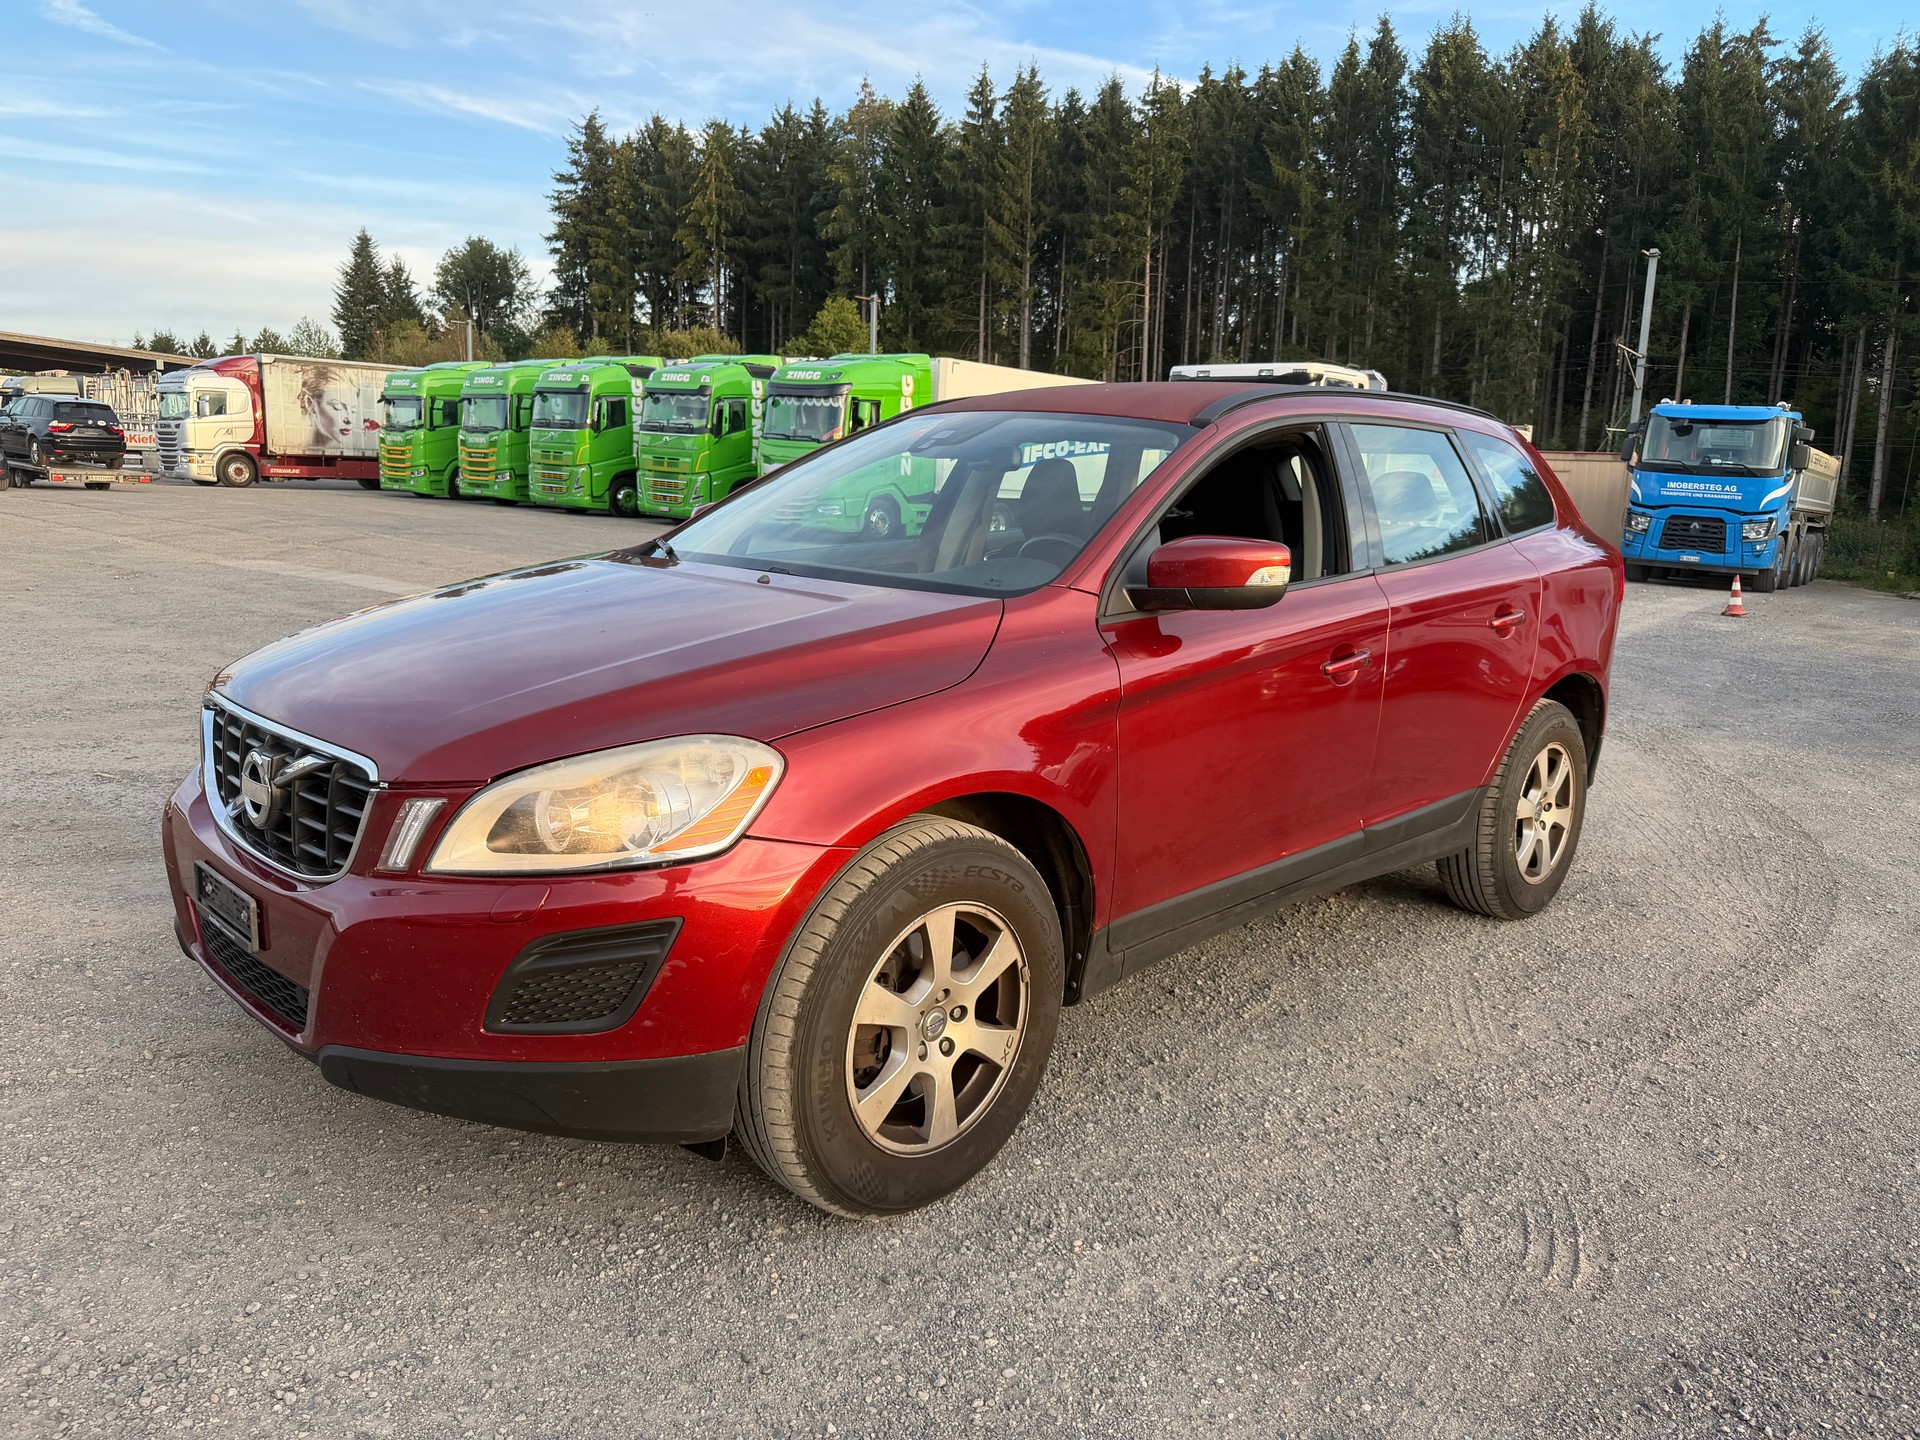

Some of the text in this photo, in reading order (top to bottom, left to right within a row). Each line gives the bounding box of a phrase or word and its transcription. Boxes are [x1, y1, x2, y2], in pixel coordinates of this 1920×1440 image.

[548, 374, 573, 382] ZINGG
[661, 373, 691, 382] ZINGG
[786, 371, 821, 380] ZINGG
[1667, 481, 1722, 491] IMOBERSTEG
[1001, 1034, 1014, 1063] XC
[817, 1034, 839, 1143] KUMHO
